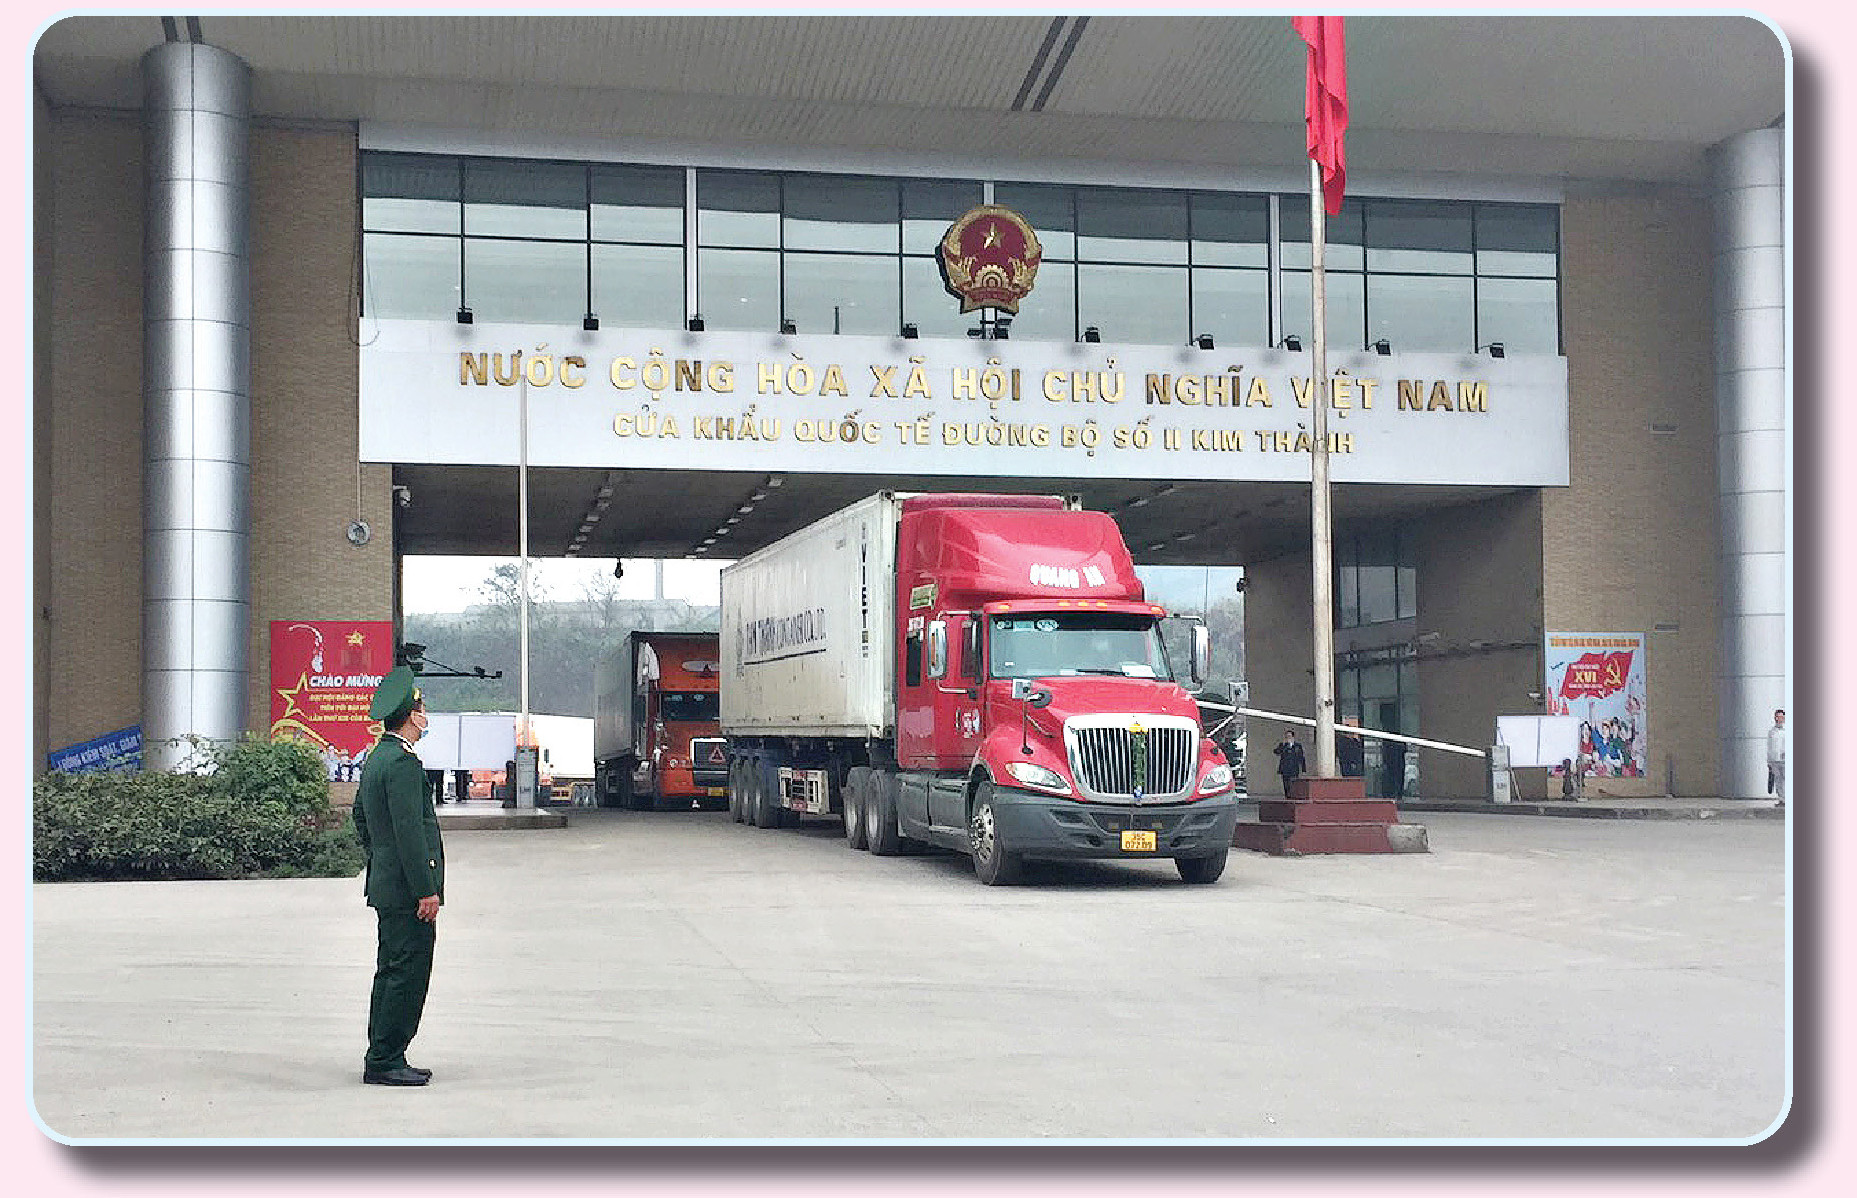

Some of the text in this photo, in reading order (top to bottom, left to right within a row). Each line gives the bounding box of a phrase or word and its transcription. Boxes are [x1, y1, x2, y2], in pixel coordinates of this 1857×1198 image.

[459, 342, 1489, 419] NƯỚC CỘNG HÒA XÃ HỘI CHỦ NGHĨA VỆT NAM
[613, 403, 681, 439] CỬA
[693, 403, 782, 441] KHẨU
[794, 408, 882, 443] QUỐC
[895, 411, 933, 445] TẾ
[1061, 418, 1101, 457] BỘ
[1113, 415, 1153, 449] SỐ
[1163, 428, 1182, 451] II
[1192, 429, 1244, 452] KIM
[1575, 671, 1597, 683] XVI
